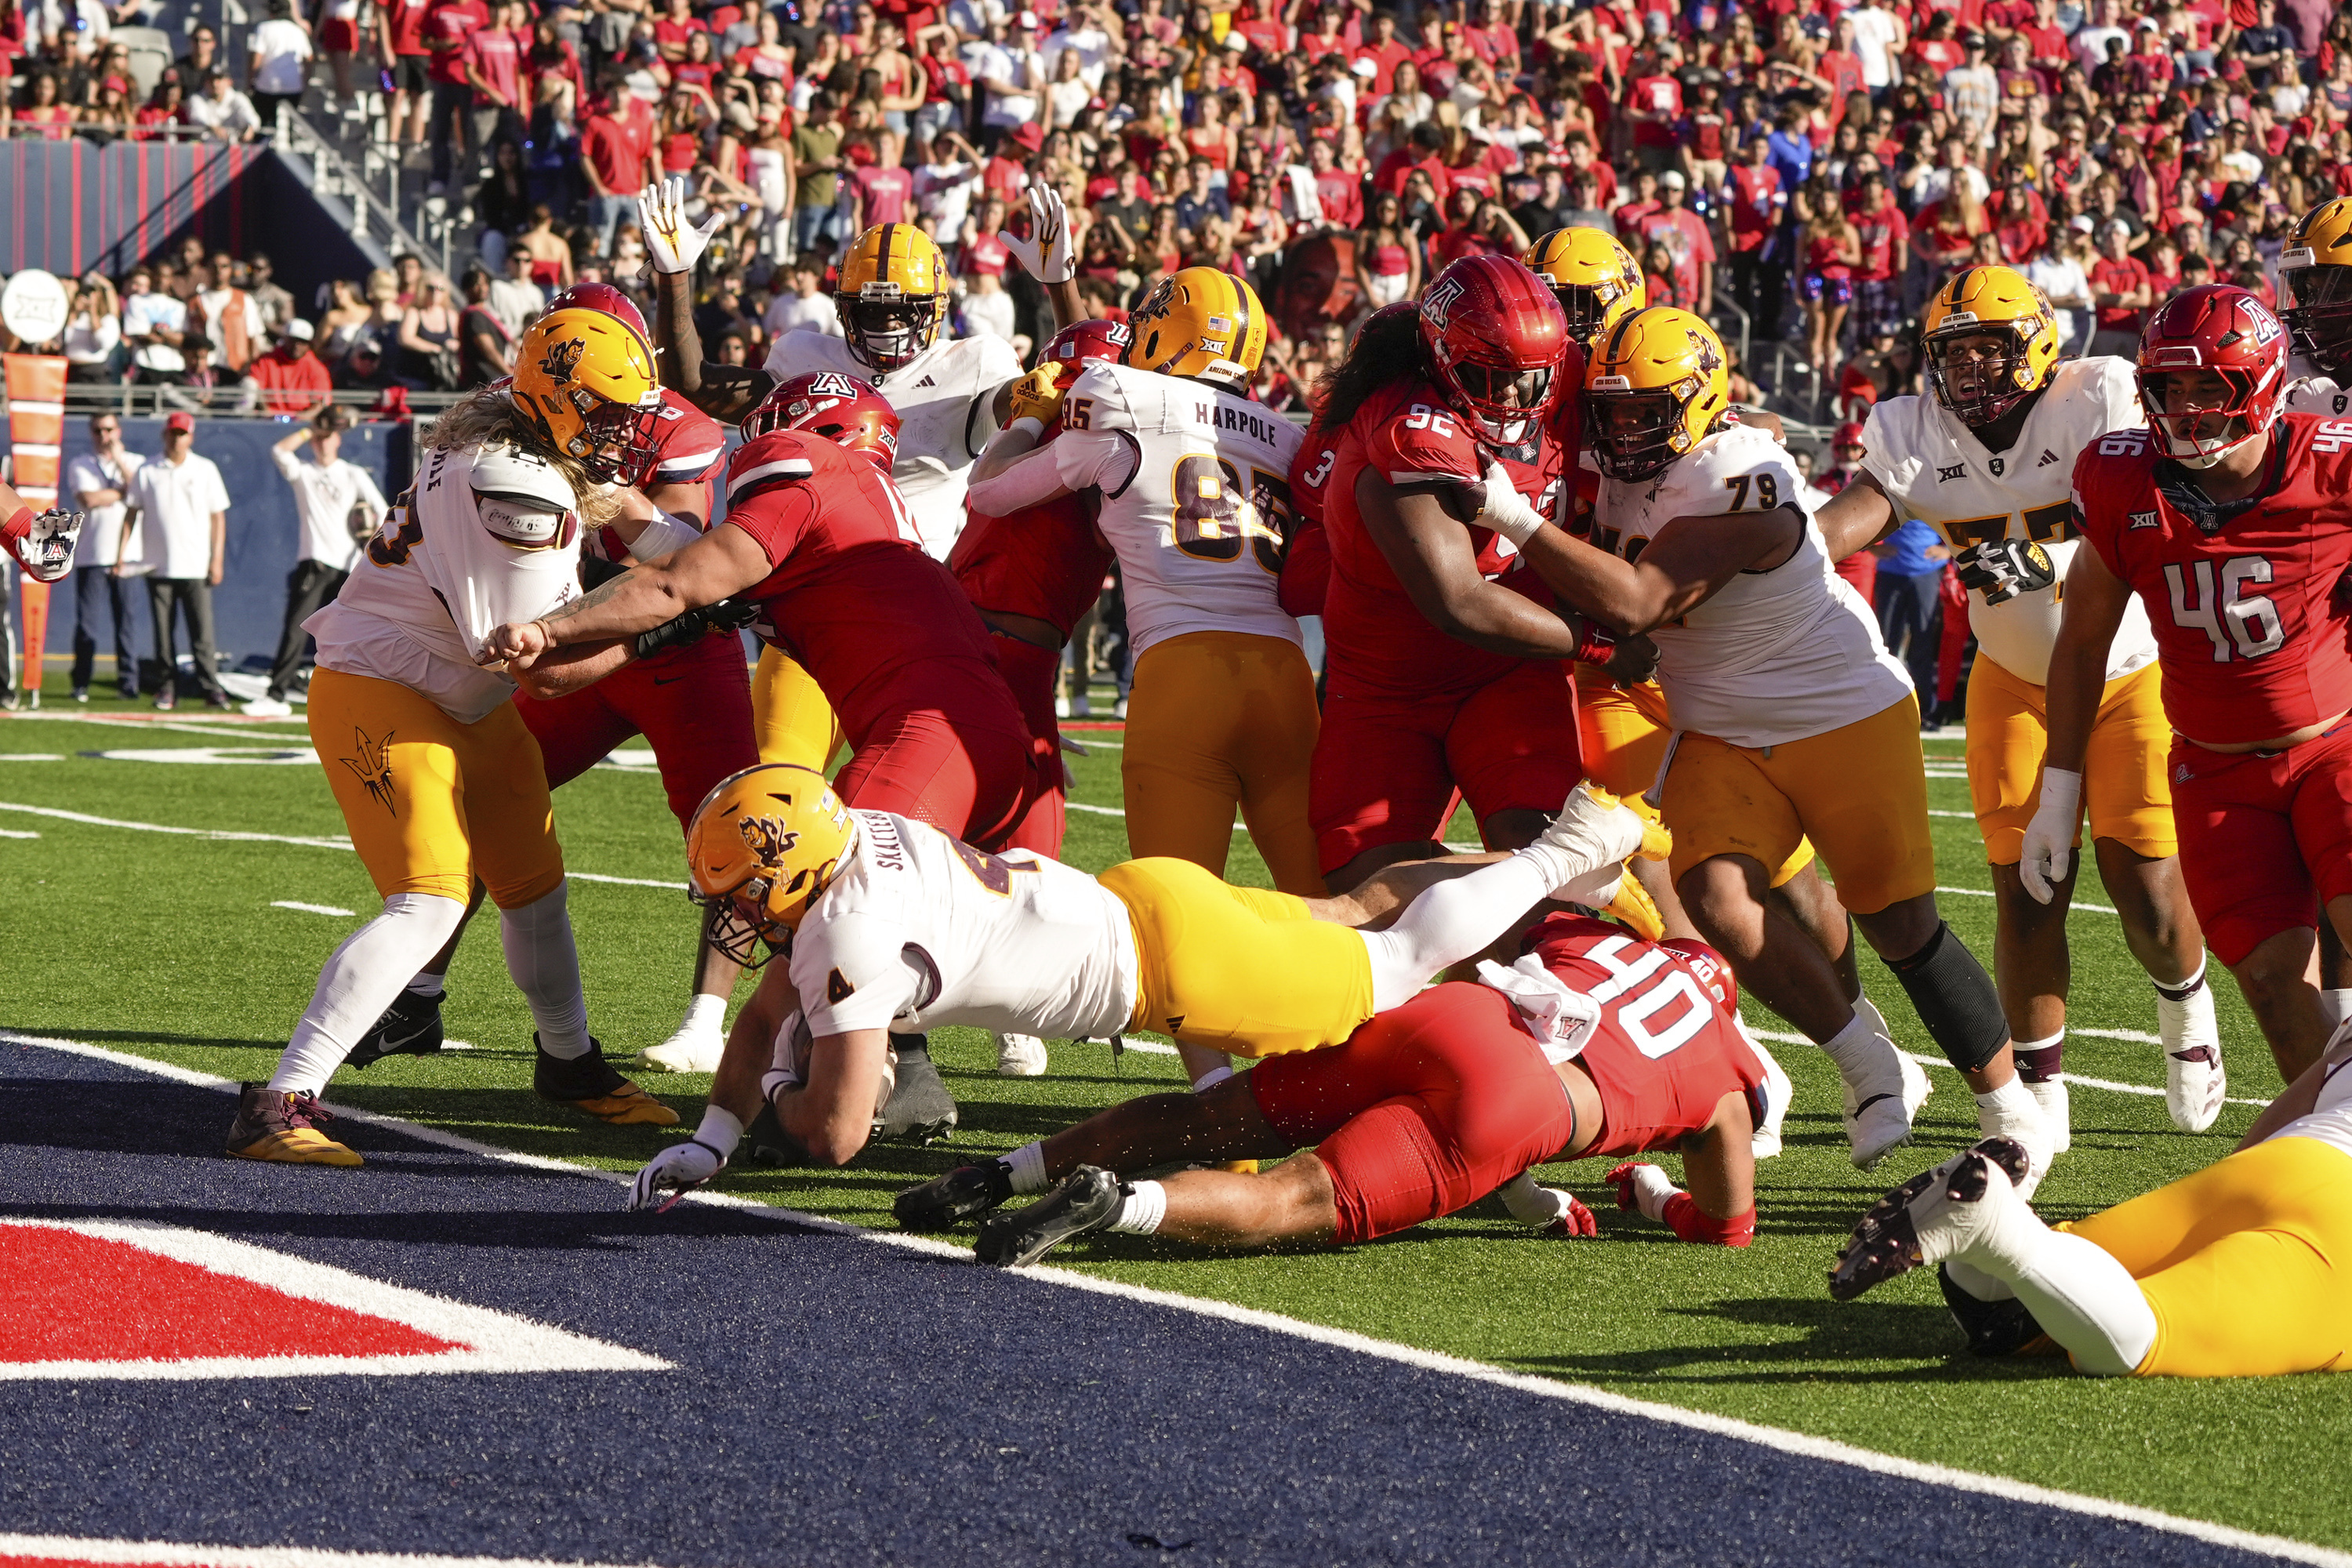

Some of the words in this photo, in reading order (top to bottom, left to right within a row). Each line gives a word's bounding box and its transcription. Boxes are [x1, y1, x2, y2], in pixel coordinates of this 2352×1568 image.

[1952, 314, 1969, 322] DEVILS
[1207, 366, 1232, 376] ARIZONA
[1016, 387, 1040, 401] adidas
[1195, 401, 1276, 448] HARPOLE
[1405, 403, 1455, 439] 92
[1723, 472, 1778, 512] 79
[1936, 463, 1968, 484] XII
[1171, 452, 1292, 579] 85
[2129, 510, 2158, 529] XII
[2162, 554, 2285, 662] 46
[827, 966, 855, 1005] 4
[1581, 931, 1715, 1062] 40
